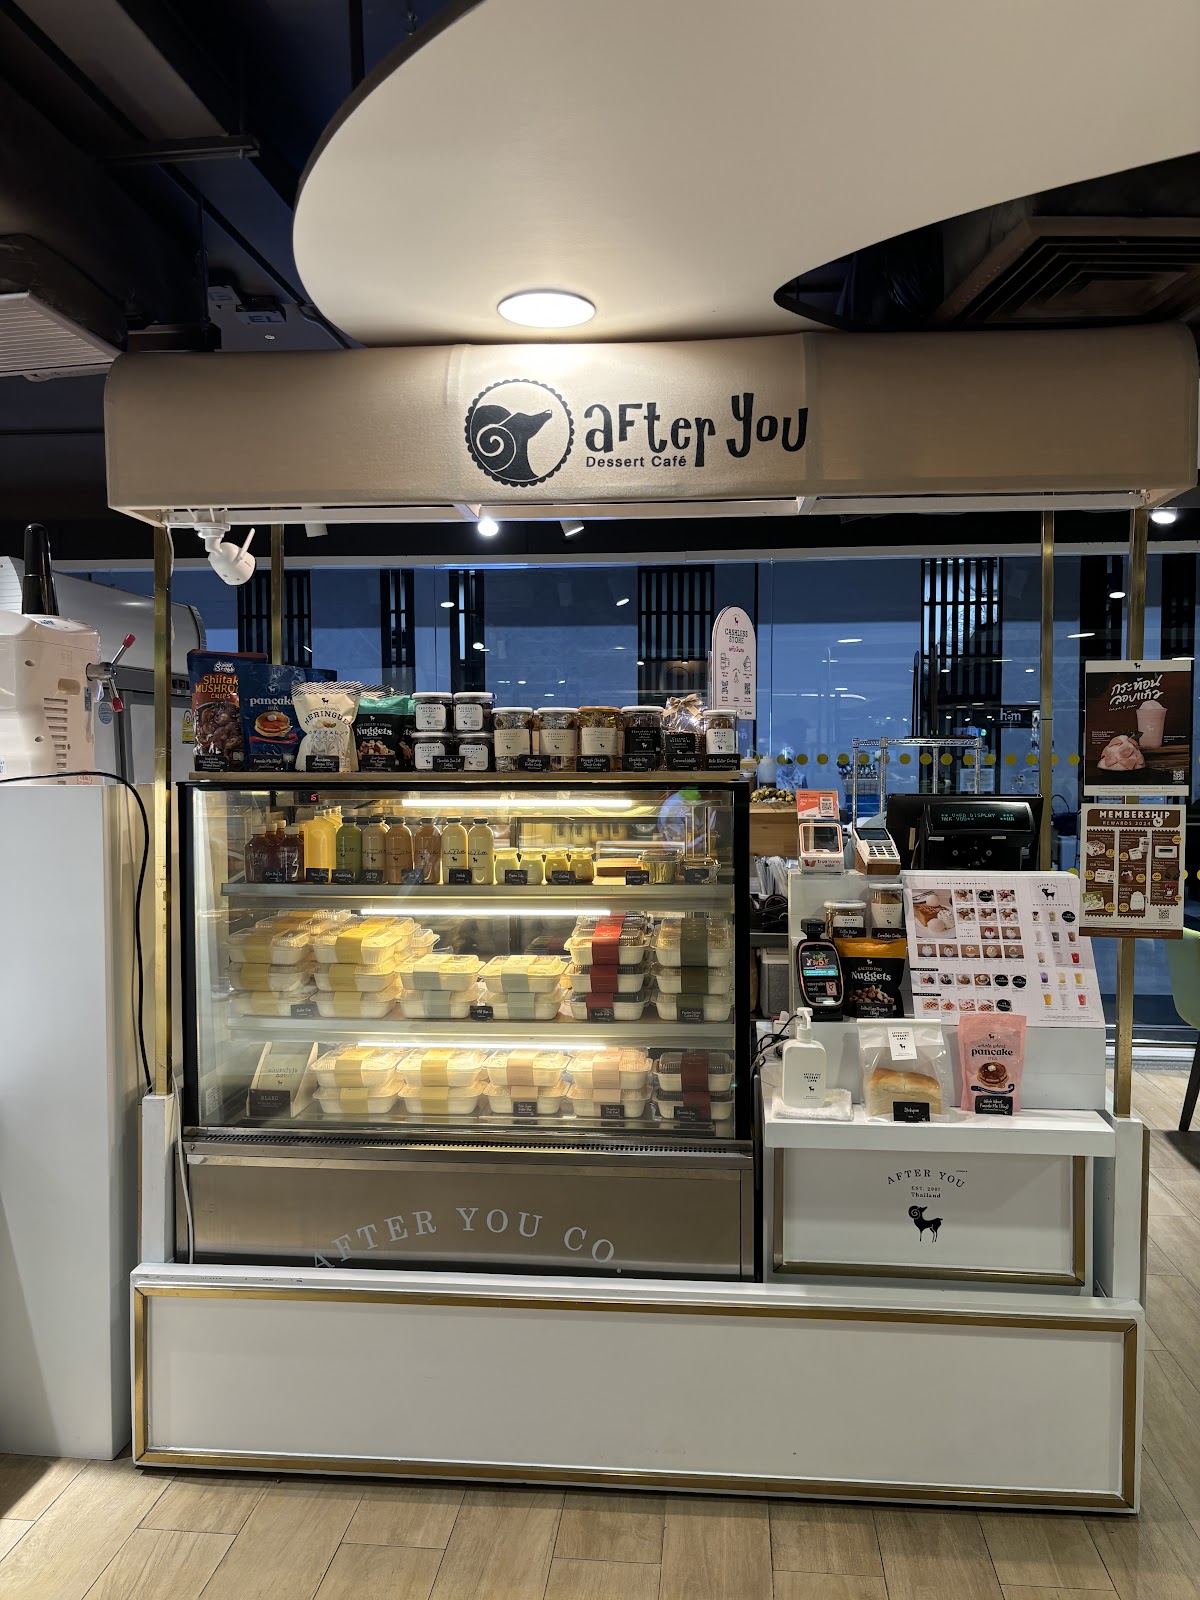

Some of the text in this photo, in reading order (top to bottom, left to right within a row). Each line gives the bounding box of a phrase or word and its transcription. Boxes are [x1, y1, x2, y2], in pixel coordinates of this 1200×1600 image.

[586, 454, 687, 467] Dessert Café
[725, 628, 748, 637] CASHLESS
[729, 636, 745, 644] STORE
[203, 675, 239, 685] Shiitak
[1111, 674, 1163, 696] กระท้อน
[304, 710, 351, 725] MERINGUE
[357, 727, 393, 737] Nuggets
[1099, 810, 1170, 819] MEMBERSHIP
[851, 971, 892, 982] Nuggets
[971, 1048, 1014, 1057] pancake
[887, 1169, 966, 1188] AFTER YOU
[313, 1207, 622, 1274] AFTER YOU CO.
